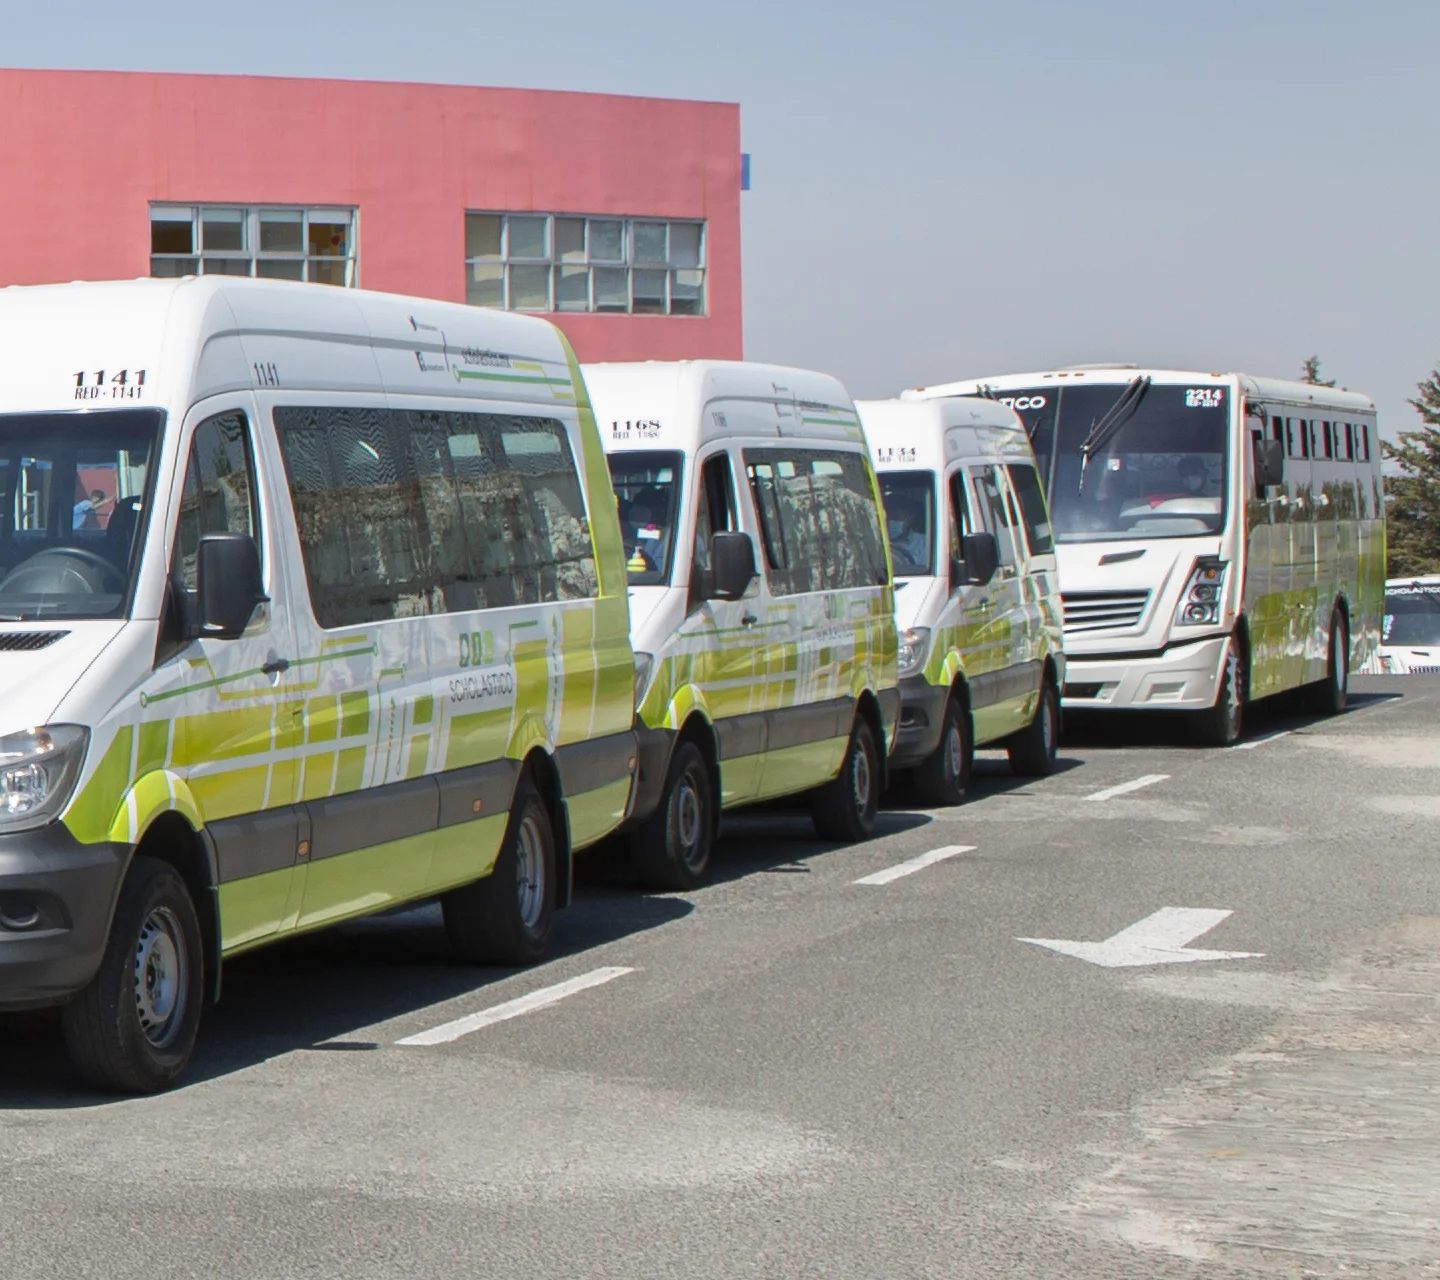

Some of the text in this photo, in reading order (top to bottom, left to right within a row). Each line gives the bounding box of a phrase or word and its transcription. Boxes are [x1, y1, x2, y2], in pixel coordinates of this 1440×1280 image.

[73, 369, 146, 387] 1141
[253, 362, 280, 386] 1141
[75, 387, 99, 400] RED
[112, 387, 141, 399] 1141
